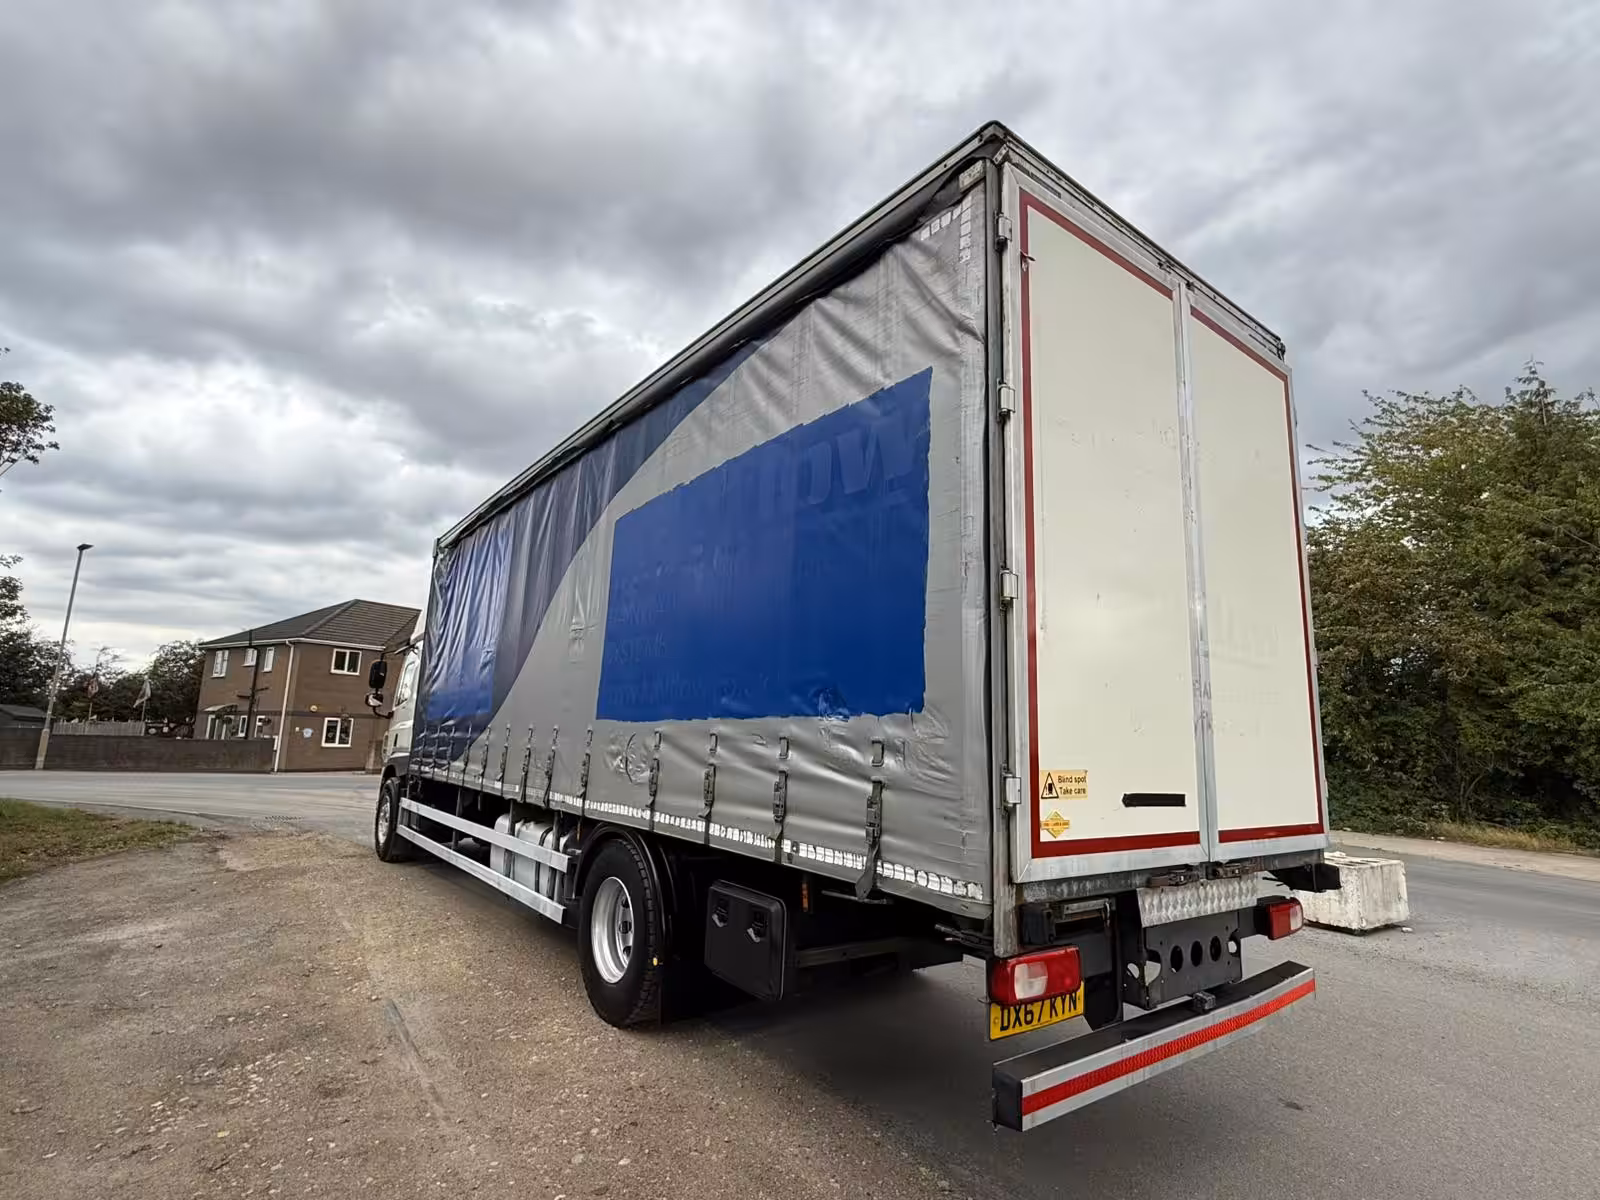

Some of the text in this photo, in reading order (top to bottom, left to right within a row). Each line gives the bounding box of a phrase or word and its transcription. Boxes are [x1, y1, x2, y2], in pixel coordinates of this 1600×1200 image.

[1058, 775, 1086, 784] Blind spot
[1059, 787, 1072, 795] Take
[1050, 992, 1077, 1018] KYN
